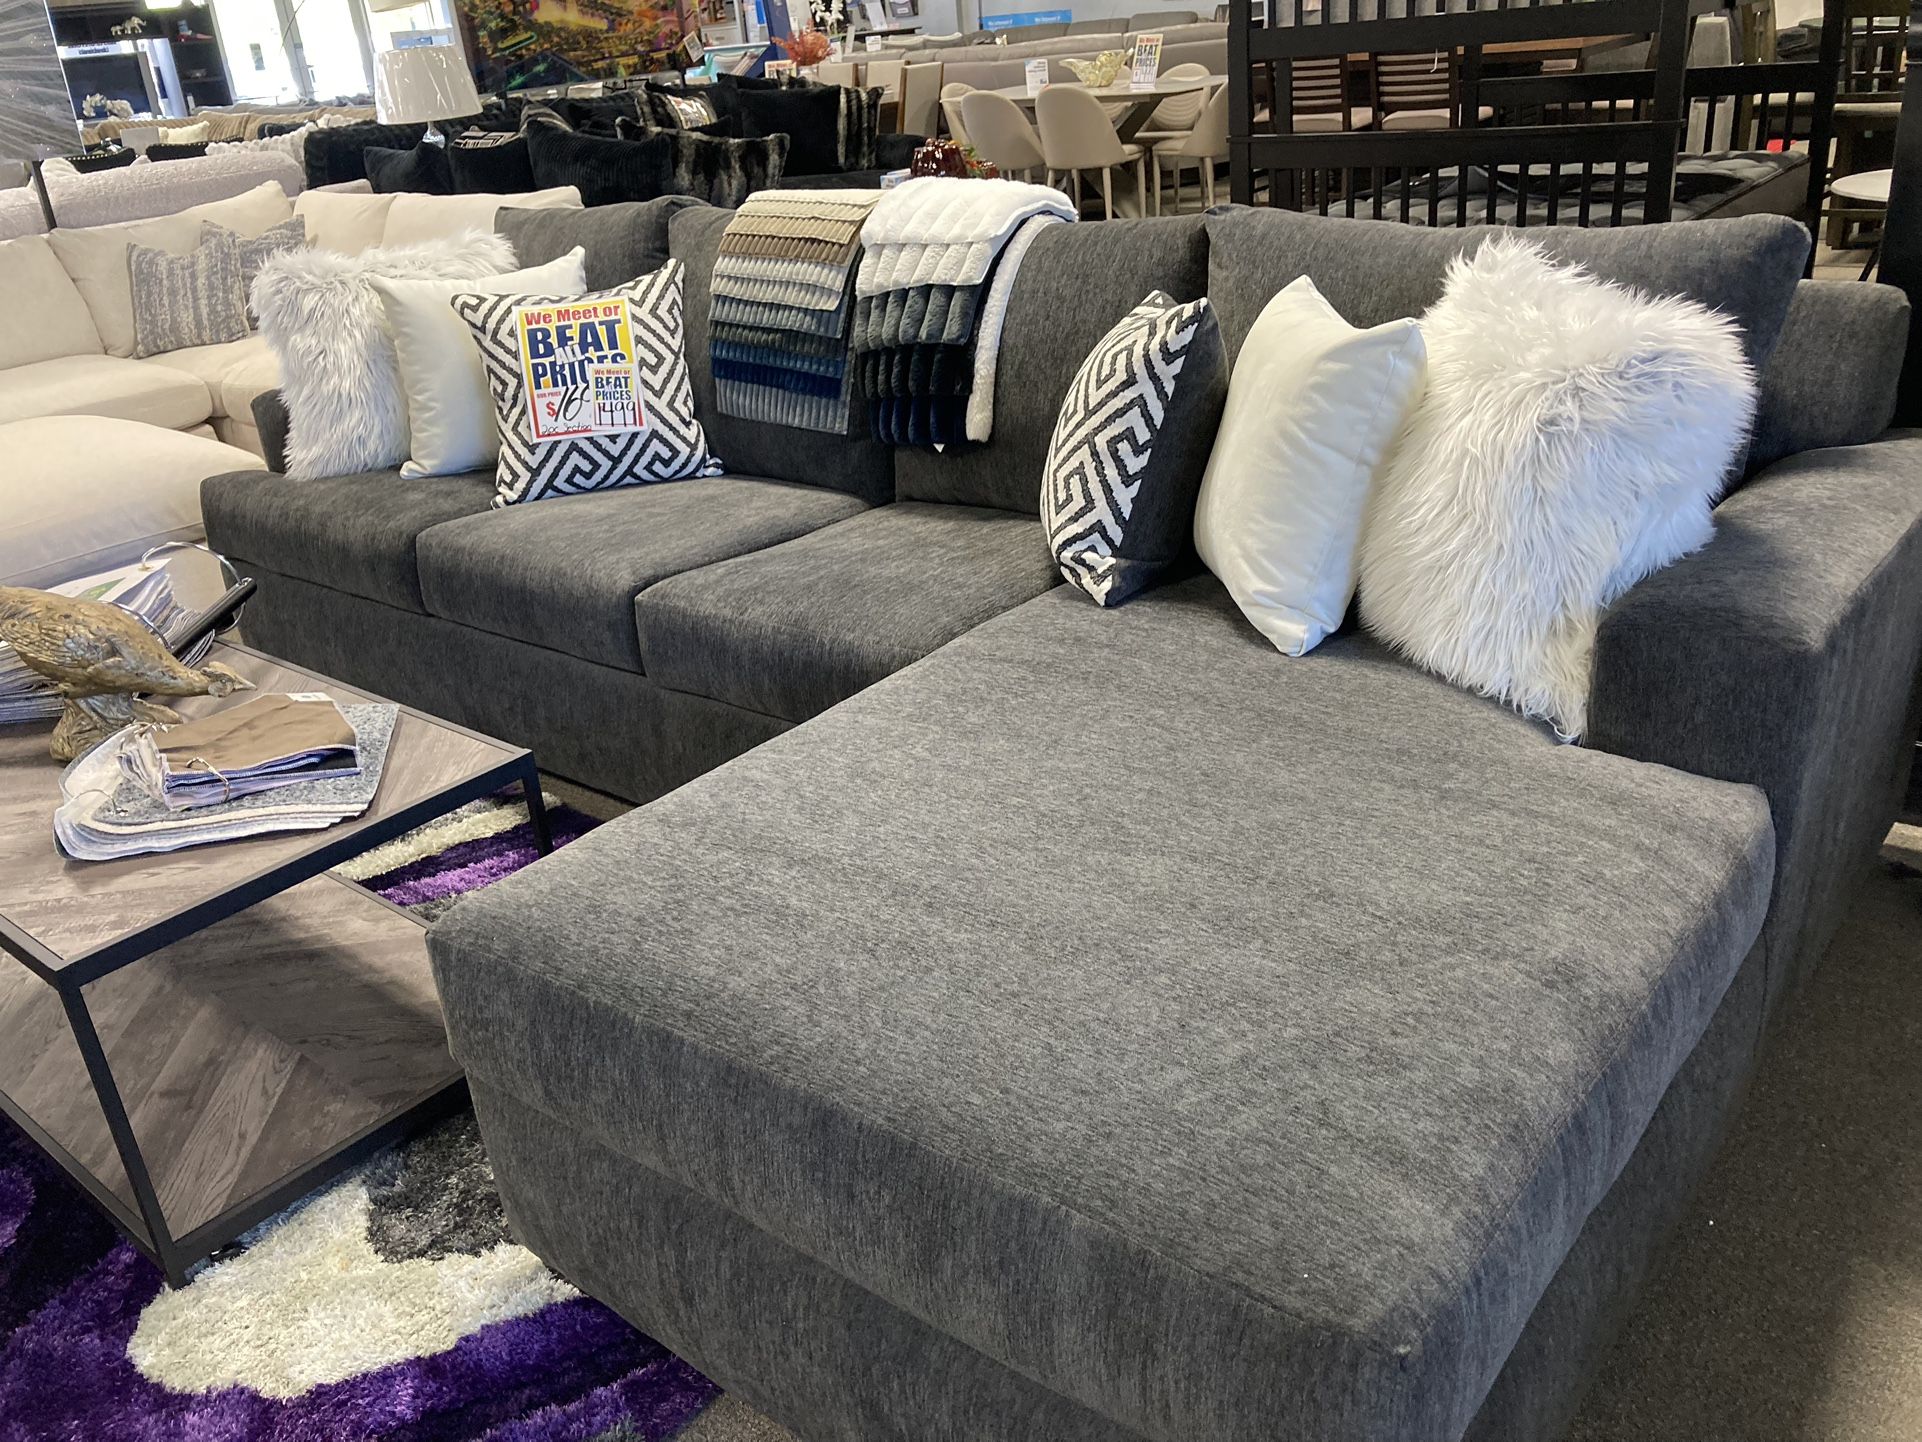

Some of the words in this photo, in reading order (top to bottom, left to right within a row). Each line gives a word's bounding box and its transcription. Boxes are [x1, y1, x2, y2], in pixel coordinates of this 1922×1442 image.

[1137, 44, 1159, 56] BEAT
[1135, 57, 1156, 67] PRICES
[525, 312, 552, 326] We
[556, 307, 600, 322] Meet
[602, 305, 620, 317] or
[527, 318, 621, 360] BEAT
[554, 343, 586, 364] ALL
[595, 376, 630, 389] BEAT
[595, 389, 632, 401] PRICES
